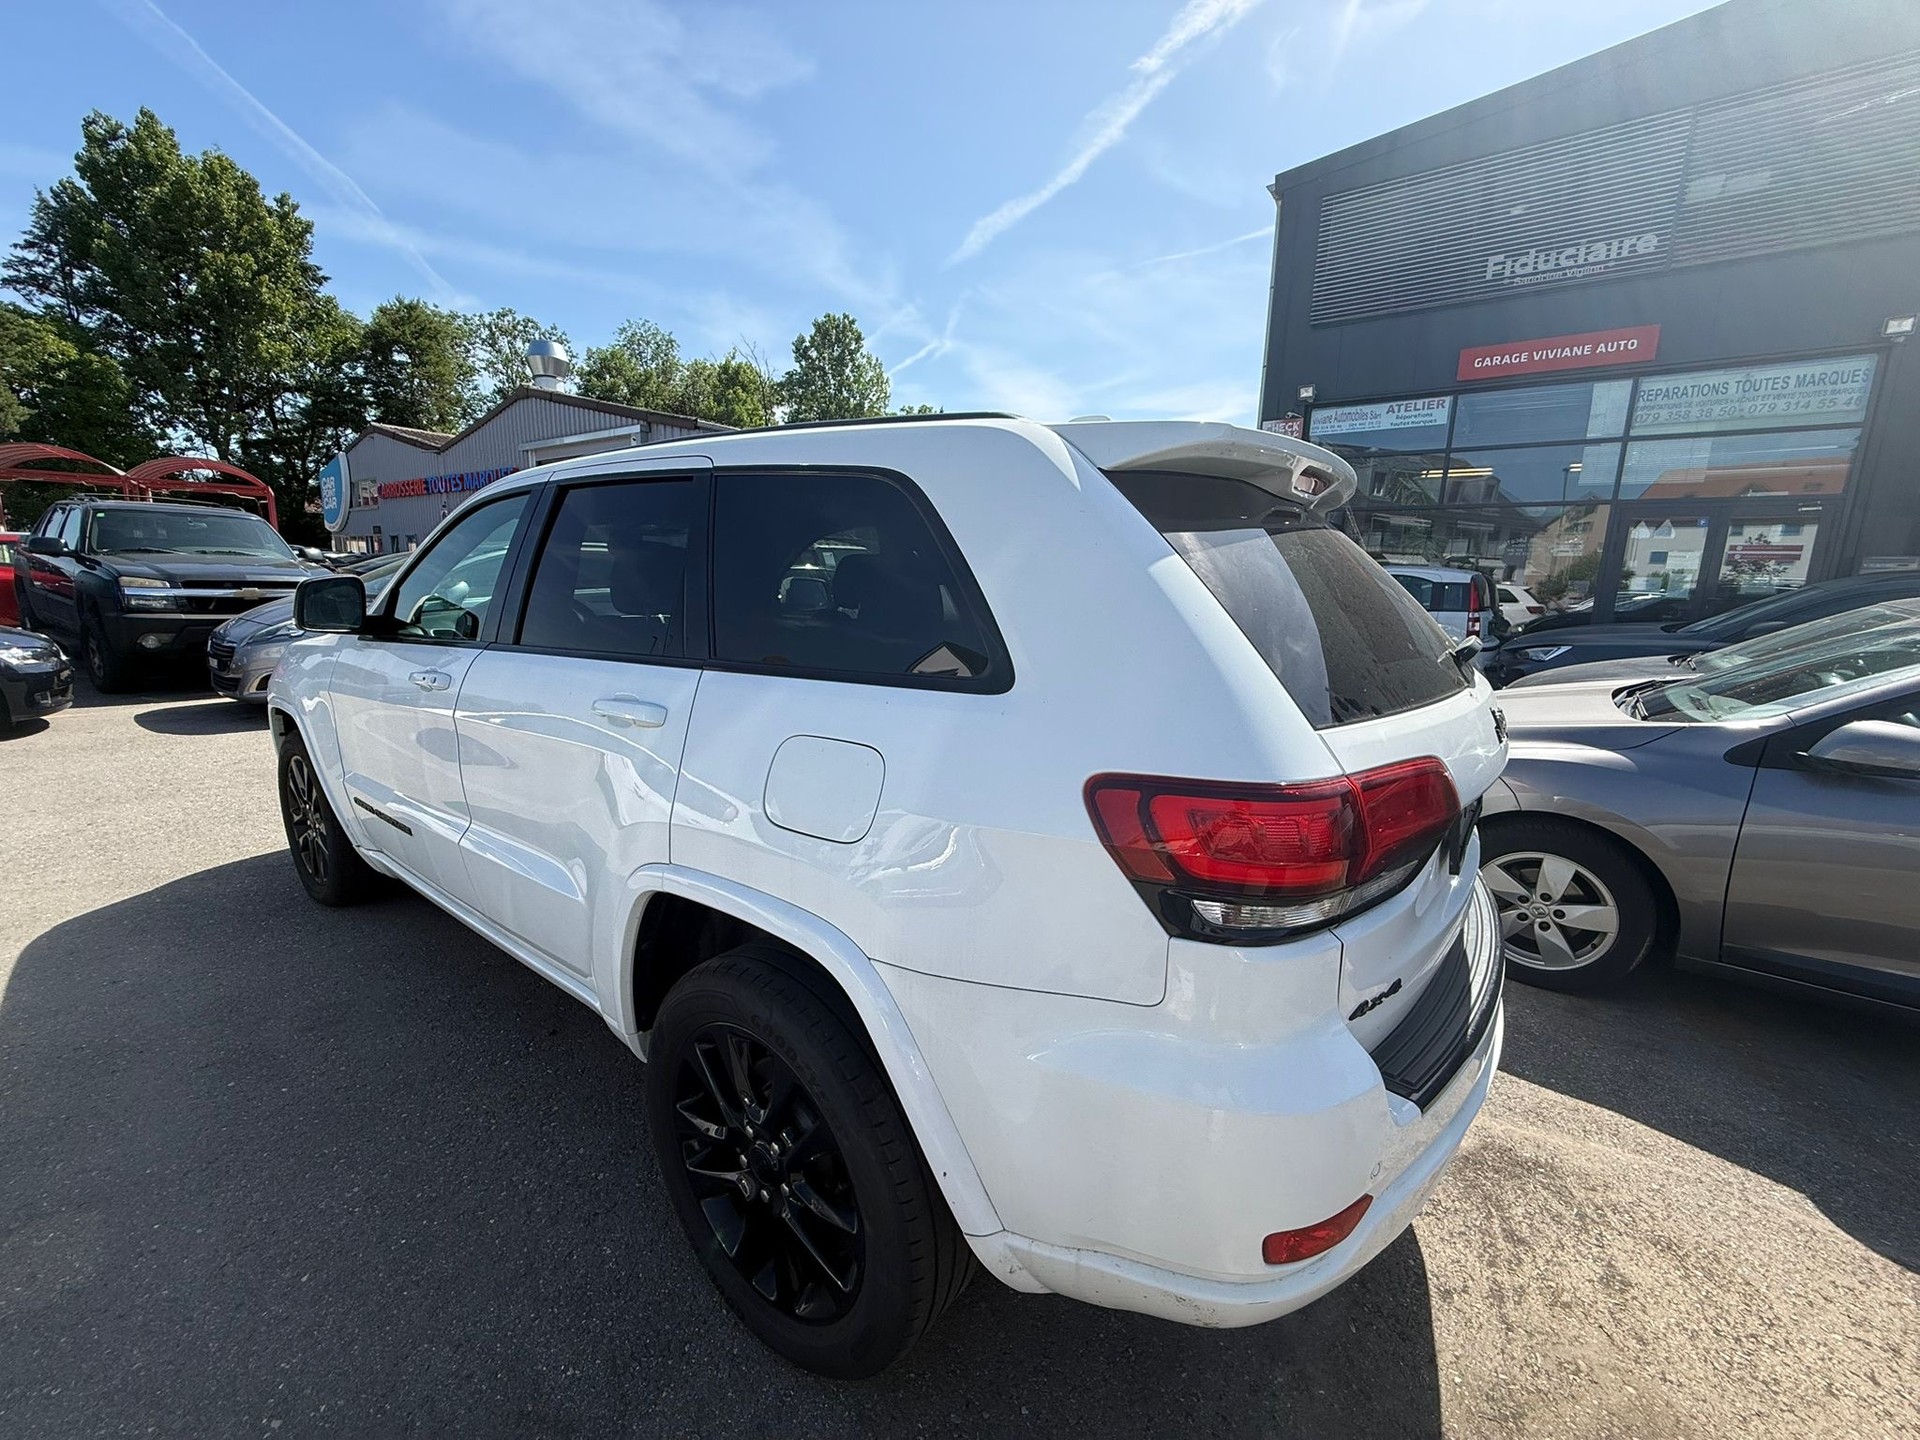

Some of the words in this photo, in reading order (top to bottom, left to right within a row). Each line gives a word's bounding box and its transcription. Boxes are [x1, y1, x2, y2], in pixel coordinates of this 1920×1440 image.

[1485, 232, 1658, 280] Fiduciaire
[1474, 352, 1529, 368] GARAGE
[1533, 344, 1593, 362] VIVIANE
[1596, 339, 1638, 354] AUTO
[1638, 381, 1729, 402] REPARATIONS
[1734, 375, 1791, 394] TOUTES
[1794, 368, 1871, 389] MARQUES
[1386, 398, 1447, 415] ATELIER
[1635, 412, 1661, 424] 079
[1664, 409, 1691, 421] 358
[1695, 407, 1714, 419] 38
[1718, 405, 1738, 417] 50
[1747, 402, 1777, 414] 079
[1782, 400, 1811, 412] 314
[1816, 397, 1839, 409] 55
[426, 472, 462, 494] TOUTES
